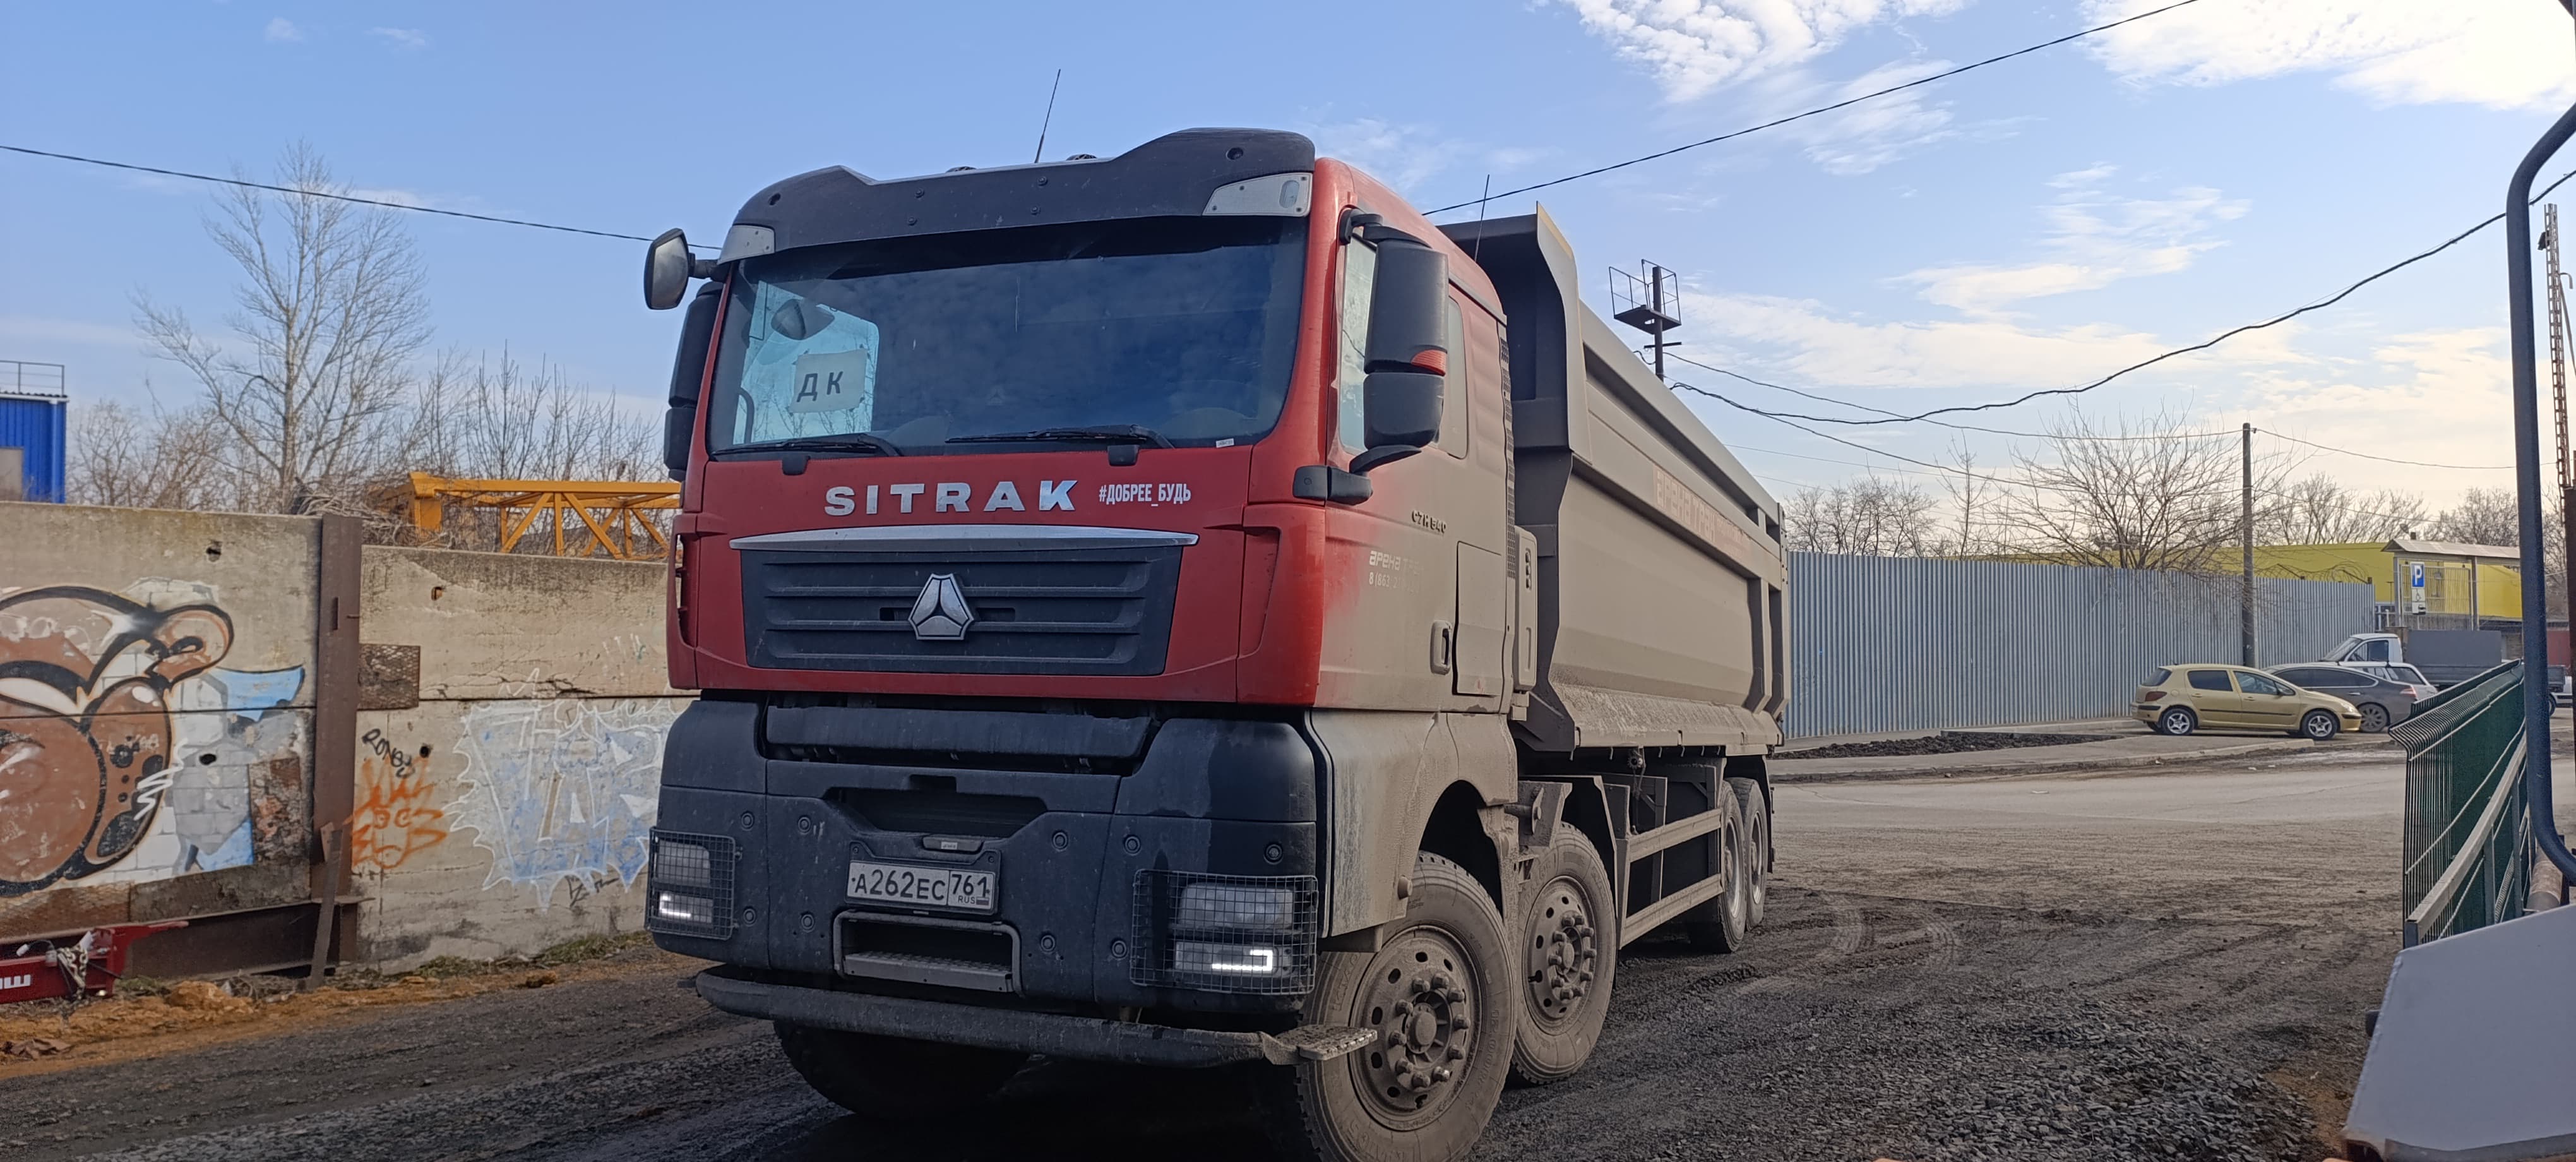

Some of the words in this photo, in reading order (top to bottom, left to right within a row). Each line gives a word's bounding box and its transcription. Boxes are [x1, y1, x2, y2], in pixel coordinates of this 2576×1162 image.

[824, 480, 1078, 517] SITRAK
[1099, 484, 1191, 506] #ДОБРЕЕ_БУДЬ
[951, 874, 987, 897] 761
[958, 895, 975, 904] RUS
